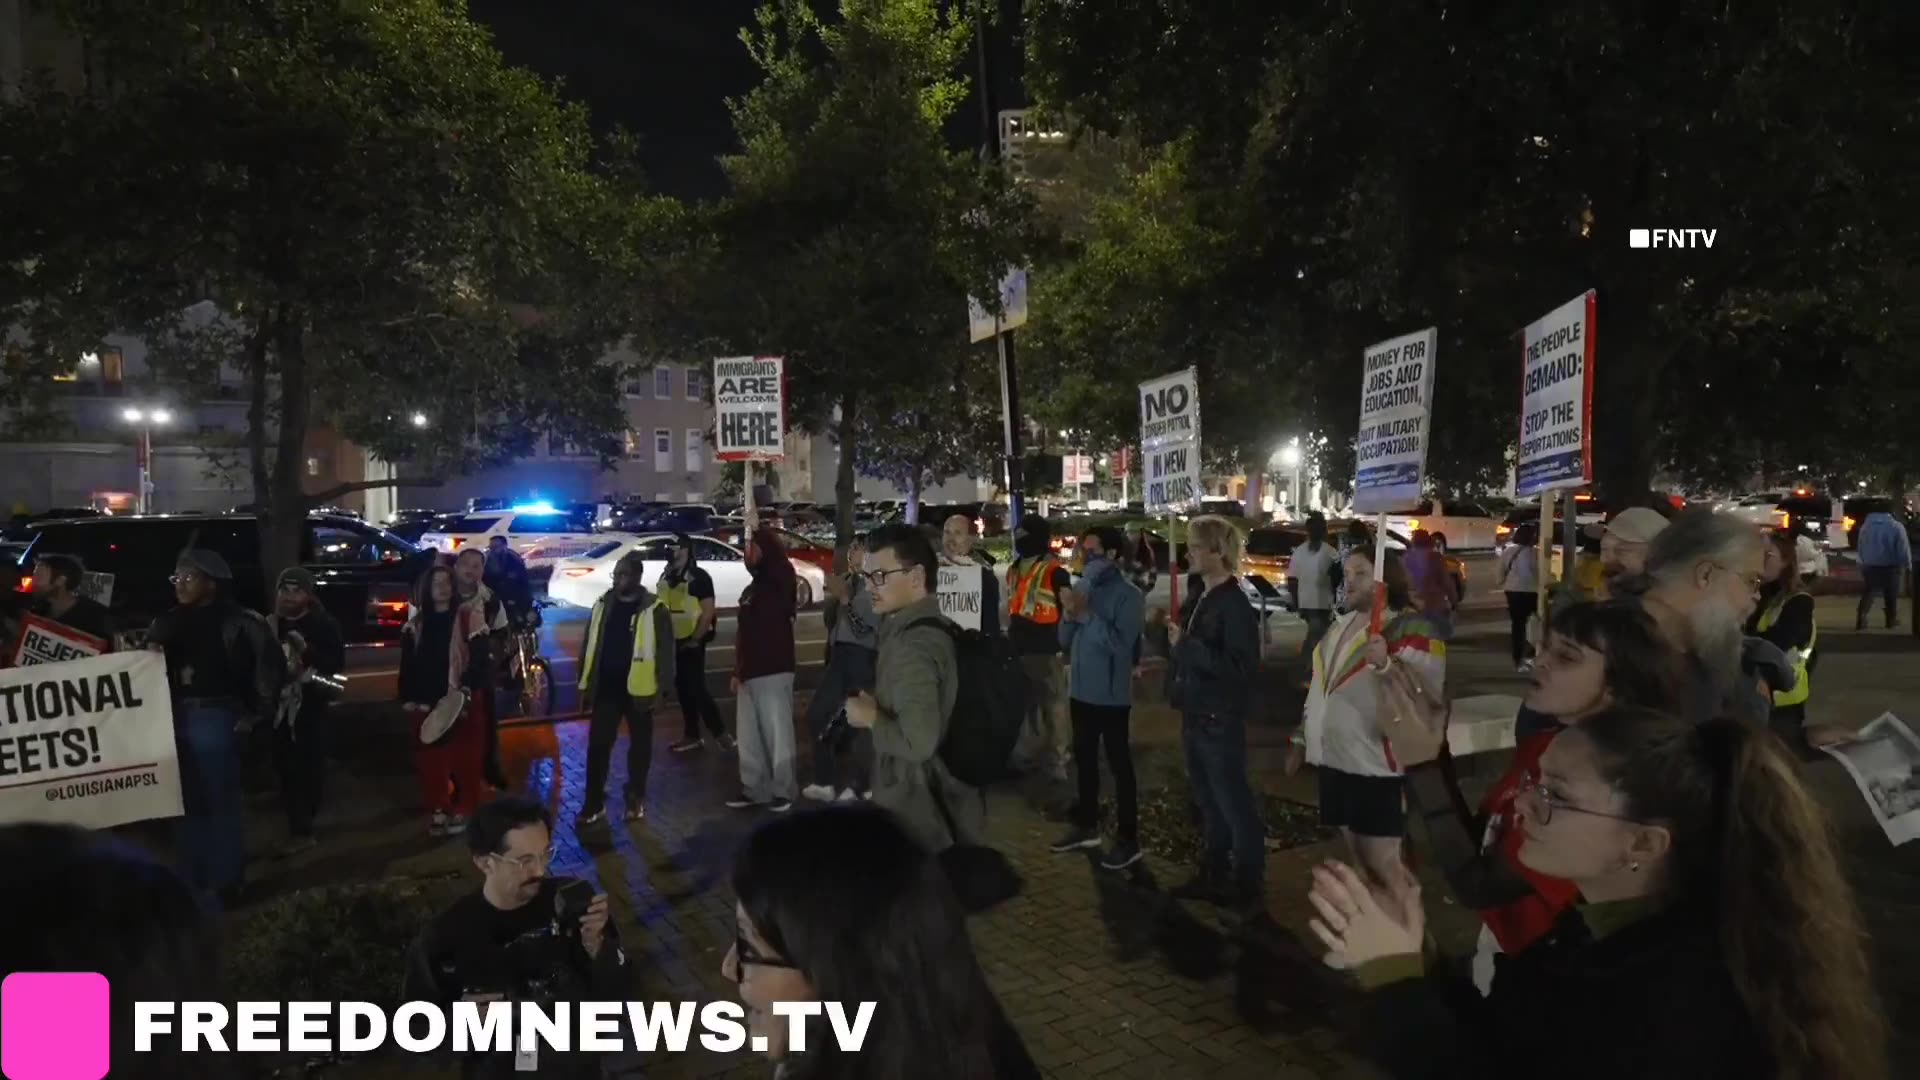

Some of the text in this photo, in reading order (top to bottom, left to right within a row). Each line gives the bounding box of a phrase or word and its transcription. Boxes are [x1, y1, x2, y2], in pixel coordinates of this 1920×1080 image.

[1367, 340, 1425, 373] MONEY FOR
[1526, 321, 1581, 365] THE PEOPLE
[717, 361, 777, 377] IMMIGRANTS
[1366, 363, 1423, 395] JOBS AND
[1525, 351, 1582, 397] DEMAND:
[718, 377, 778, 395] ARE
[718, 394, 779, 404] WELCOME
[1364, 385, 1422, 414] EDUCATION,
[1144, 384, 1189, 422] NO
[1525, 400, 1574, 436] STOP THE
[721, 411, 779, 447] HERE
[1377, 416, 1422, 440] MILITARY
[1153, 453, 1162, 479] IN
[1164, 448, 1187, 476] NEW
[1360, 435, 1419, 462] OCCUPATION!
[1150, 476, 1194, 505] ORLEANS
[940, 571, 958, 585] TOP
[936, 591, 980, 614] TATIONS
[24, 629, 94, 662] REJEC
[0, 671, 143, 726] TIONAL
[46, 773, 159, 801] @LOUISIANAPSL
